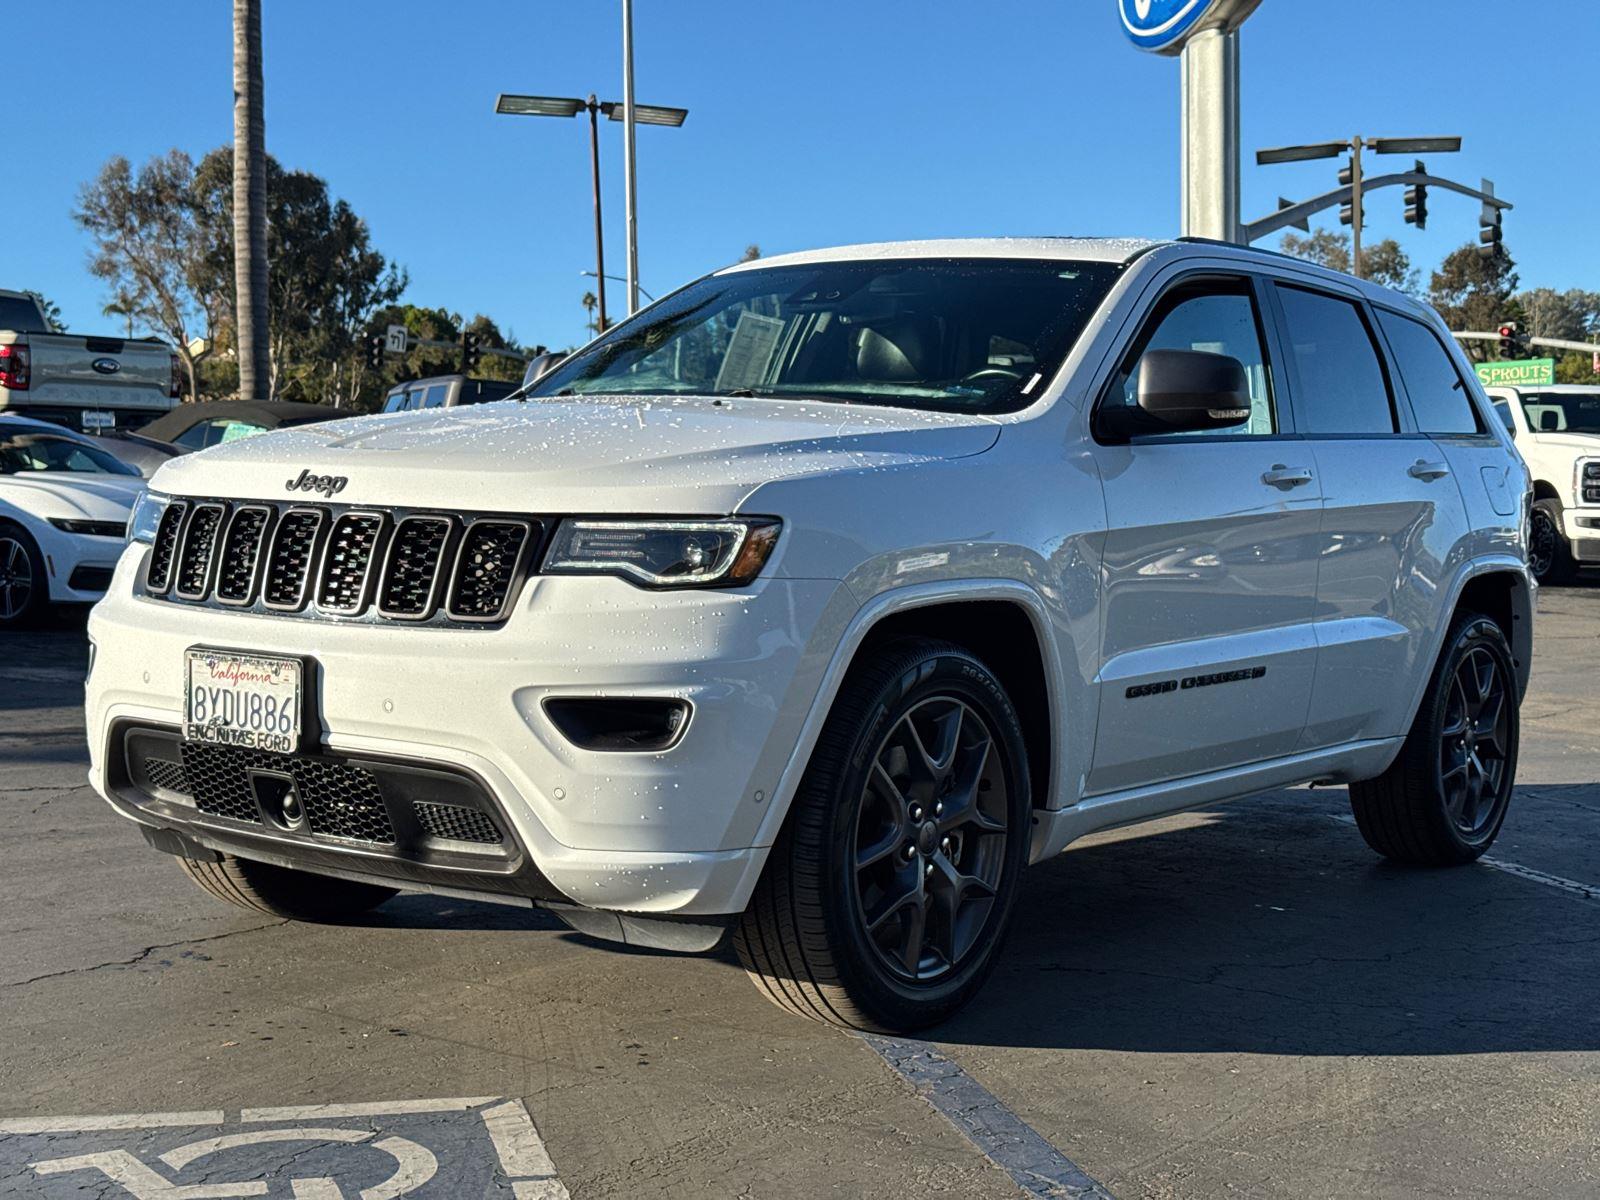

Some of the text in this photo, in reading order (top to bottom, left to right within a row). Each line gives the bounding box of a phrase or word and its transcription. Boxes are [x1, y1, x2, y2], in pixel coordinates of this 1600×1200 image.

[1479, 366, 1550, 385] SPROUTS
[286, 469, 348, 498] Jeep
[210, 662, 278, 686] California
[194, 686, 293, 734] 8YDU886
[257, 732, 291, 752] FORD
